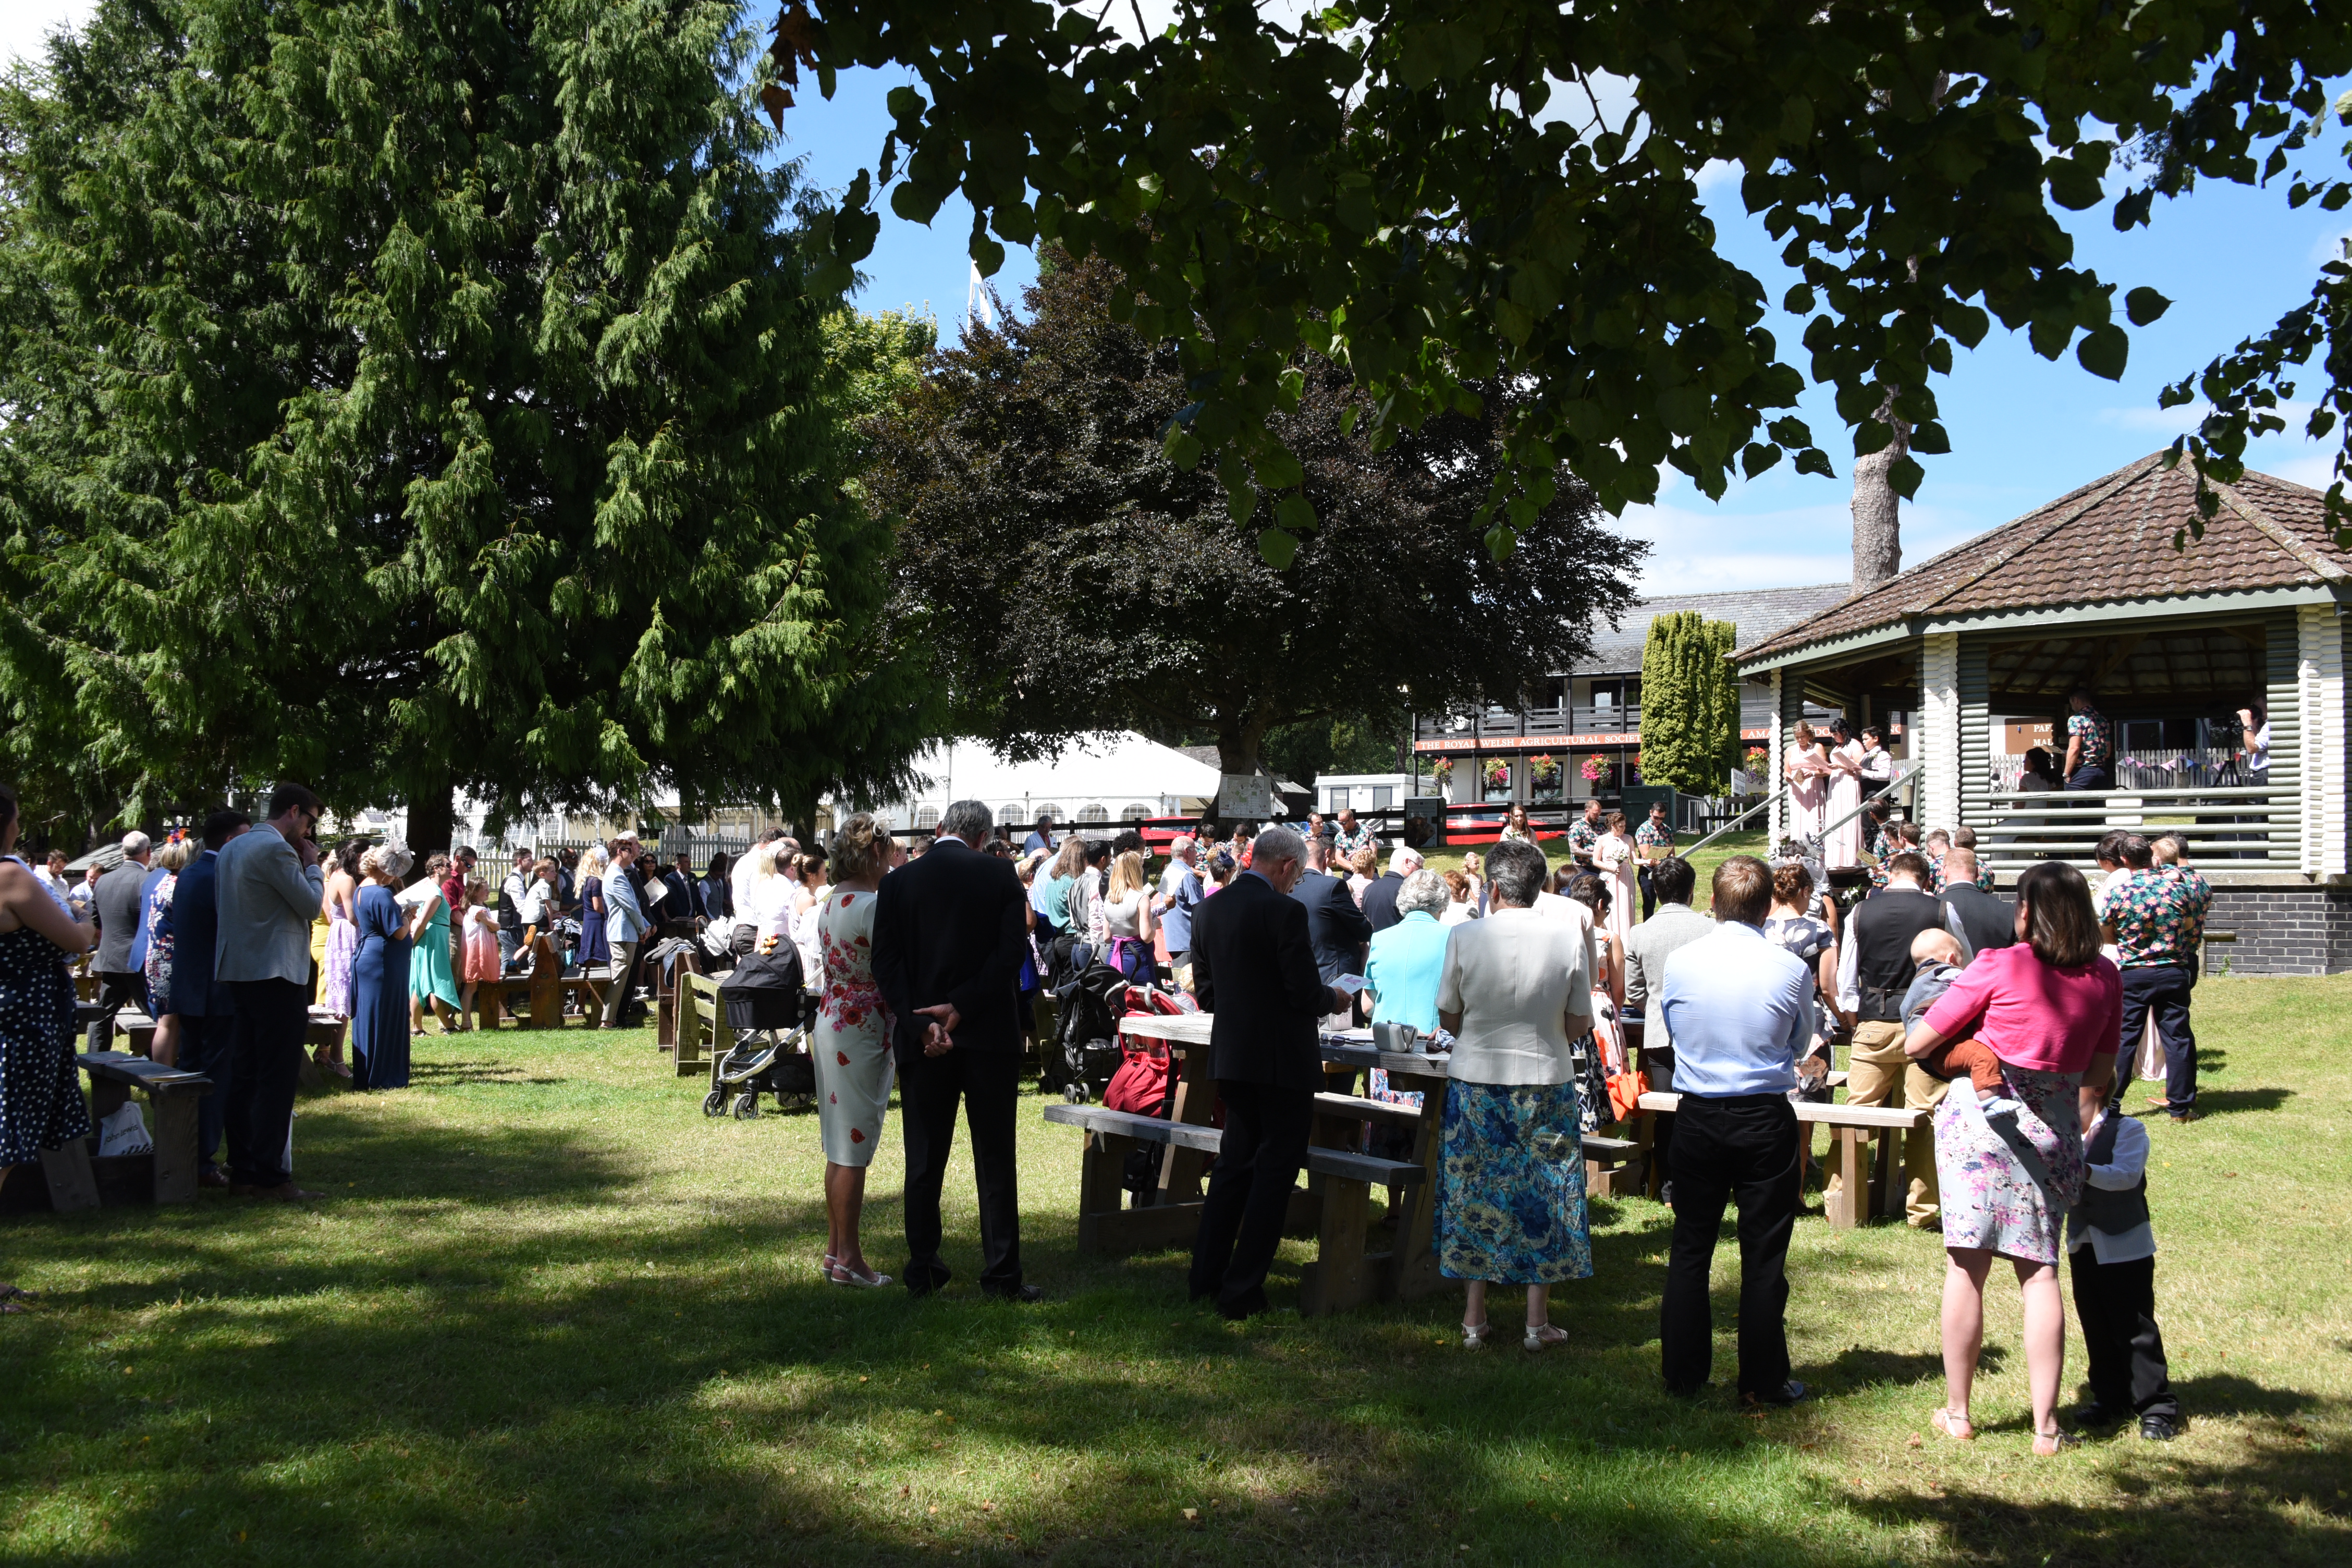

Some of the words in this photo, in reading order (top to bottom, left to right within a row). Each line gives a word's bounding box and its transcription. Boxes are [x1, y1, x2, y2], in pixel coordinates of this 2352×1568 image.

[1444, 740, 1475, 749] ROYAL
[1481, 739, 1514, 747] WELSH
[1519, 736, 1600, 746] AGRICULTURAL
[1605, 734, 1642, 743] SOCIET
[120, 1123, 138, 1137] Lewis
